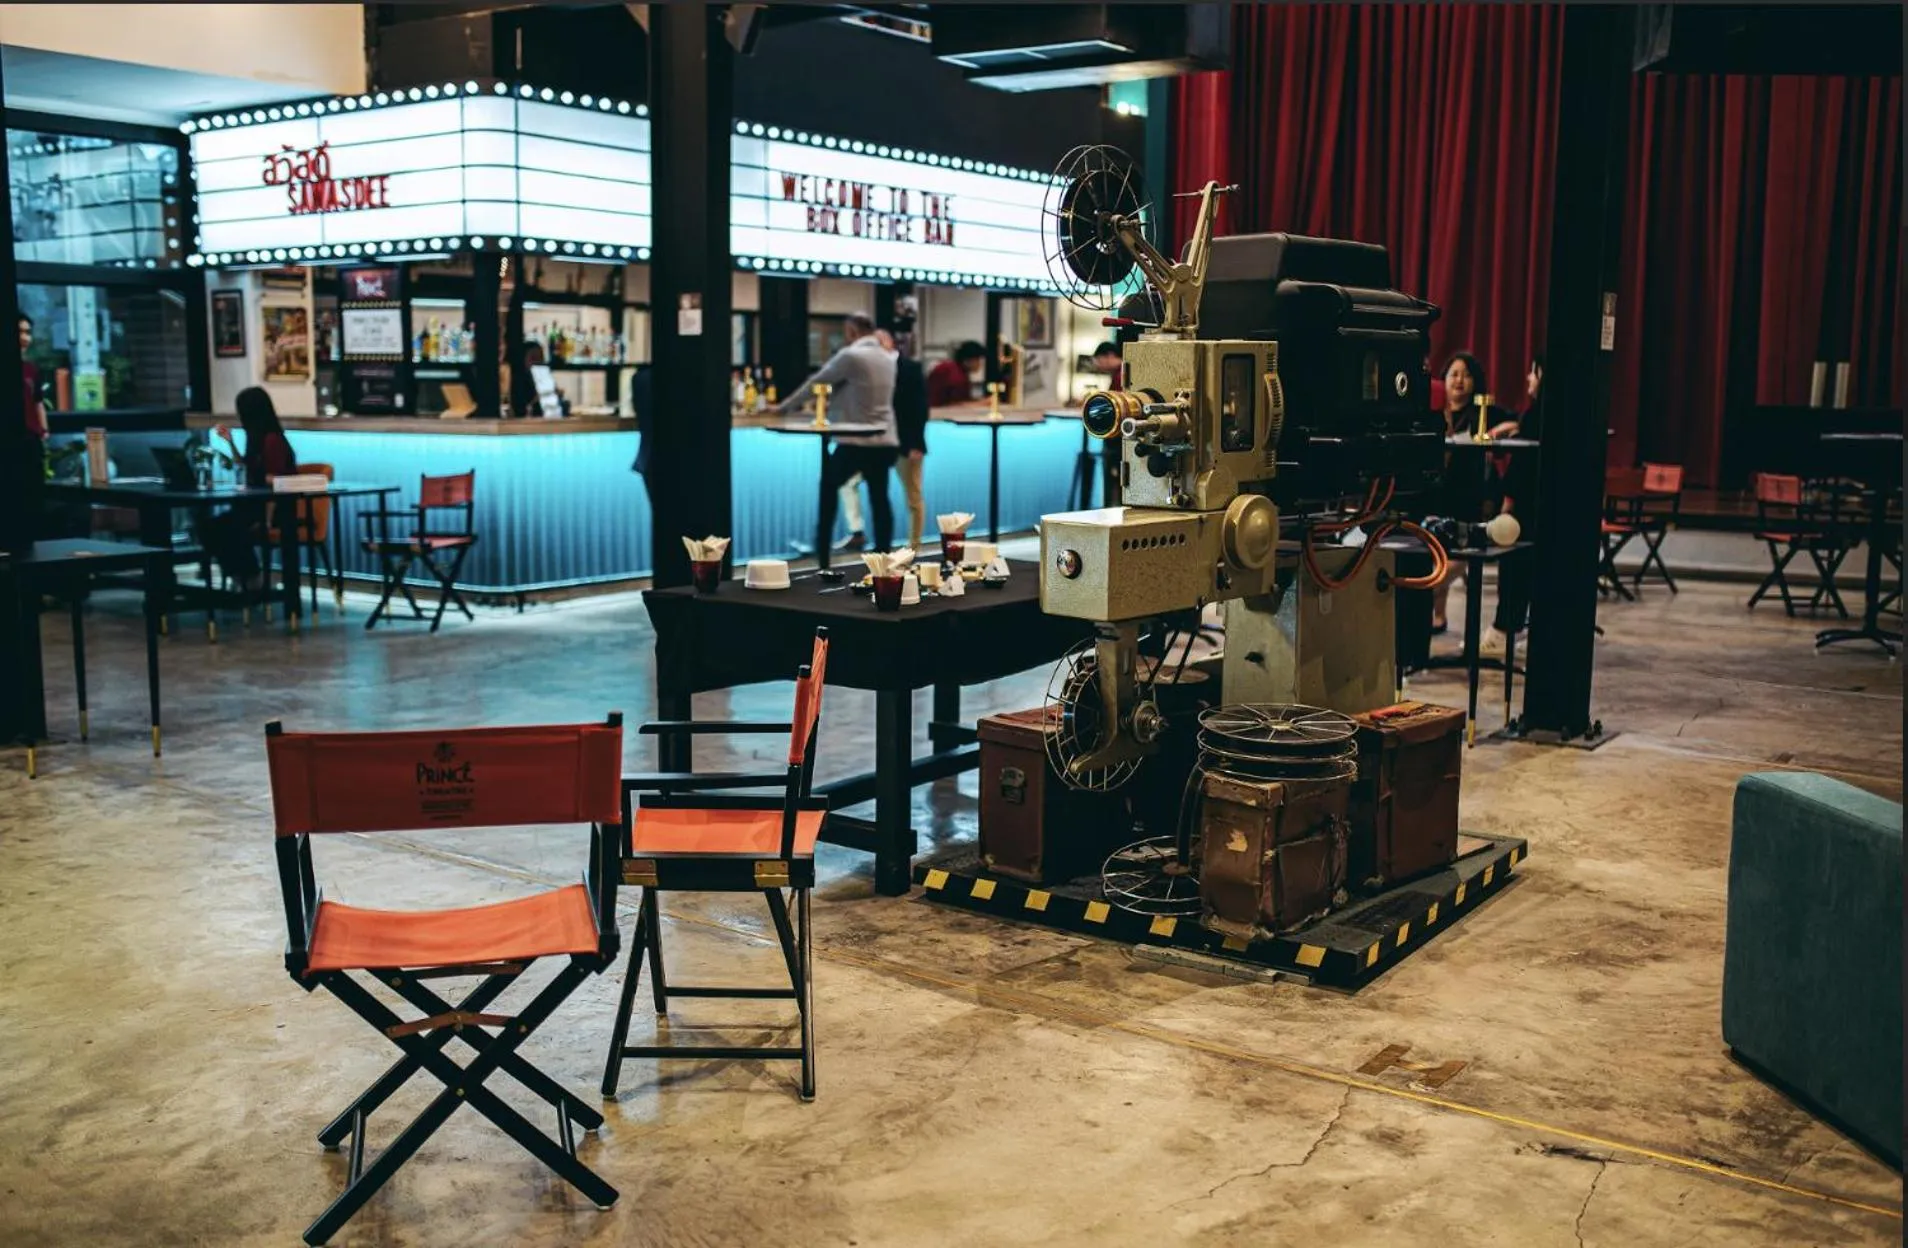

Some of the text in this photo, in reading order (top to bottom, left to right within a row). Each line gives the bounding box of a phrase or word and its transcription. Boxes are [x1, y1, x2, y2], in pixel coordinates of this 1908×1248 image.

[262, 140, 331, 184] สวัสดี
[288, 175, 390, 215] SAWASDEE
[781, 171, 952, 220] WELCOME TO THE
[807, 206, 955, 247] BOX OFFICE BAR
